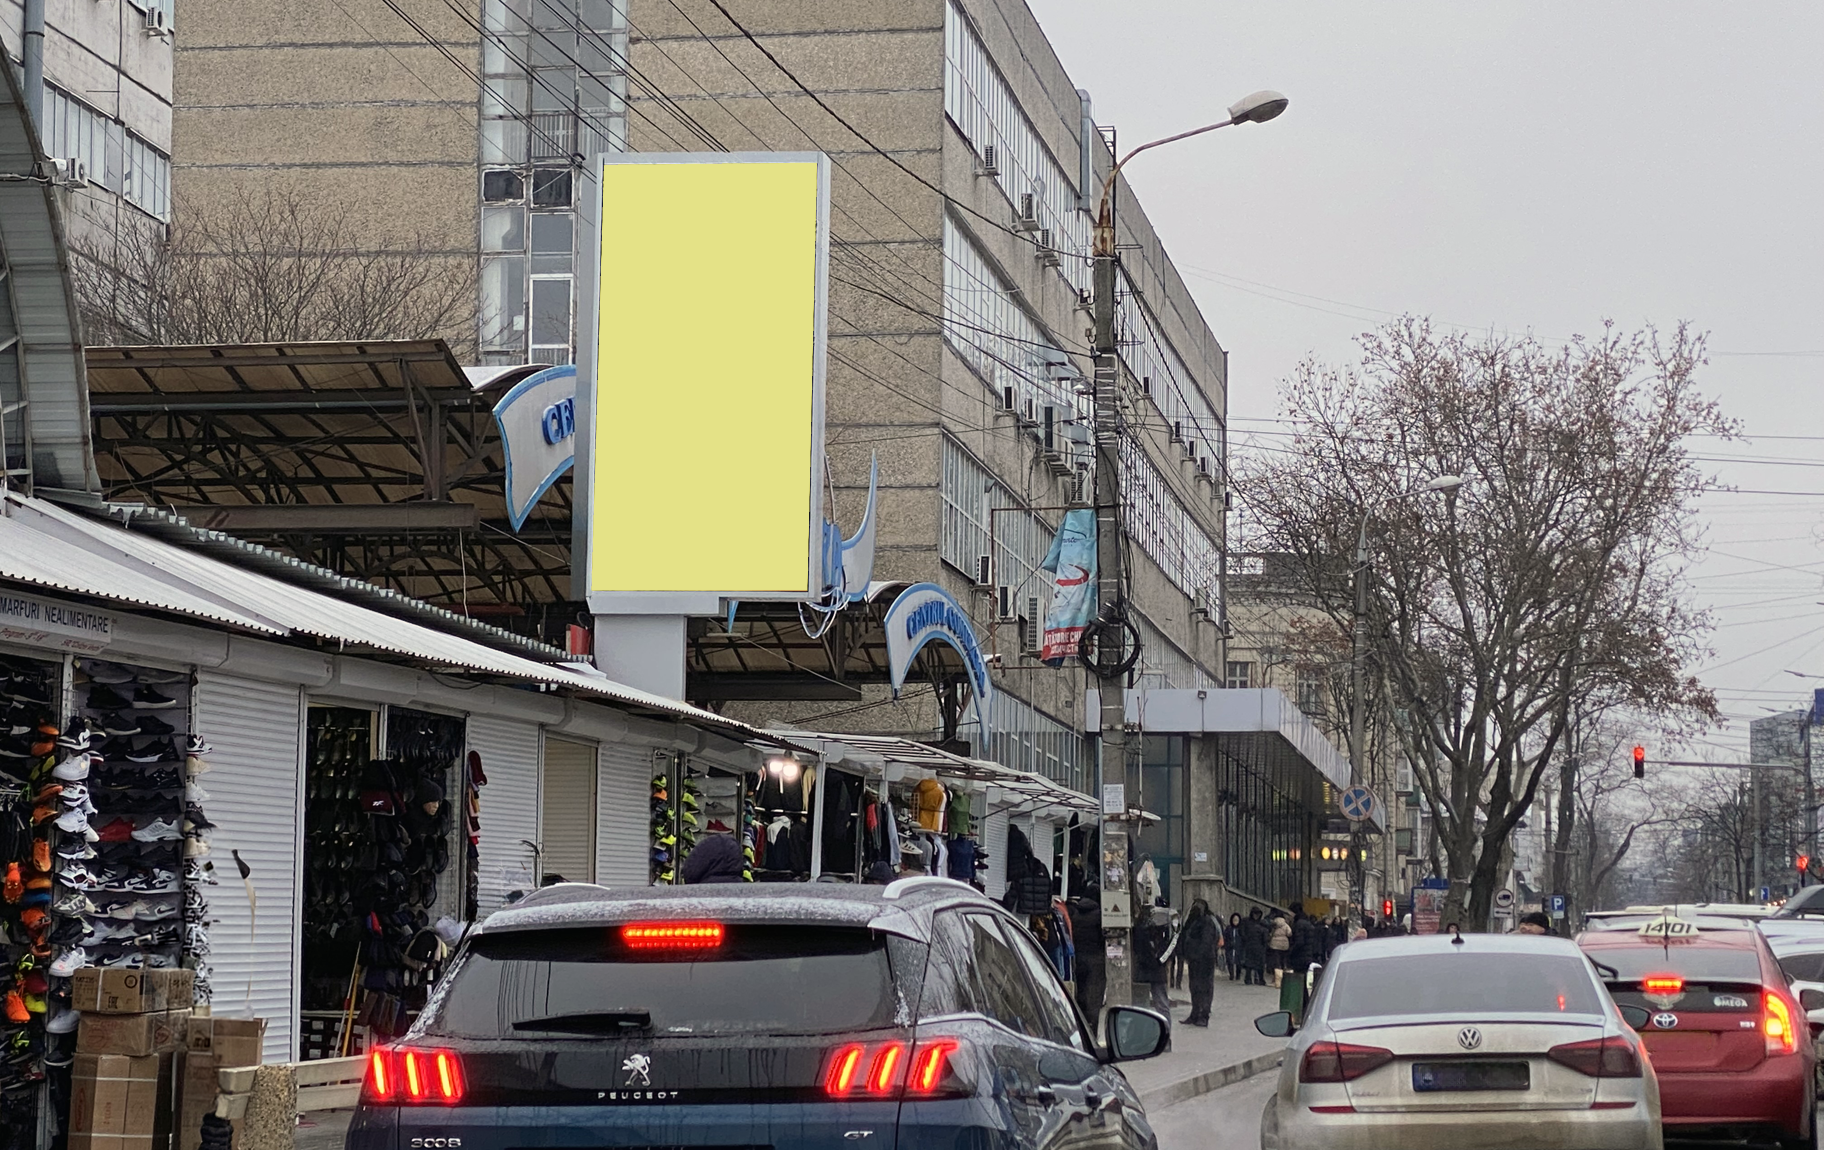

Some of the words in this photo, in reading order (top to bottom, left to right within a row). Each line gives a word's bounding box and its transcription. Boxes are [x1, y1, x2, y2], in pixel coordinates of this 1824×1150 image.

[542, 397, 575, 446] CE
[0, 597, 40, 620] MARFURI
[45, 606, 109, 634] NEALIMENTARE
[1553, 897, 1563, 910] P
[597, 1091, 678, 1100] PEUGEOT
[843, 1130, 874, 1140] GT
[410, 1137, 462, 1148] 3008
